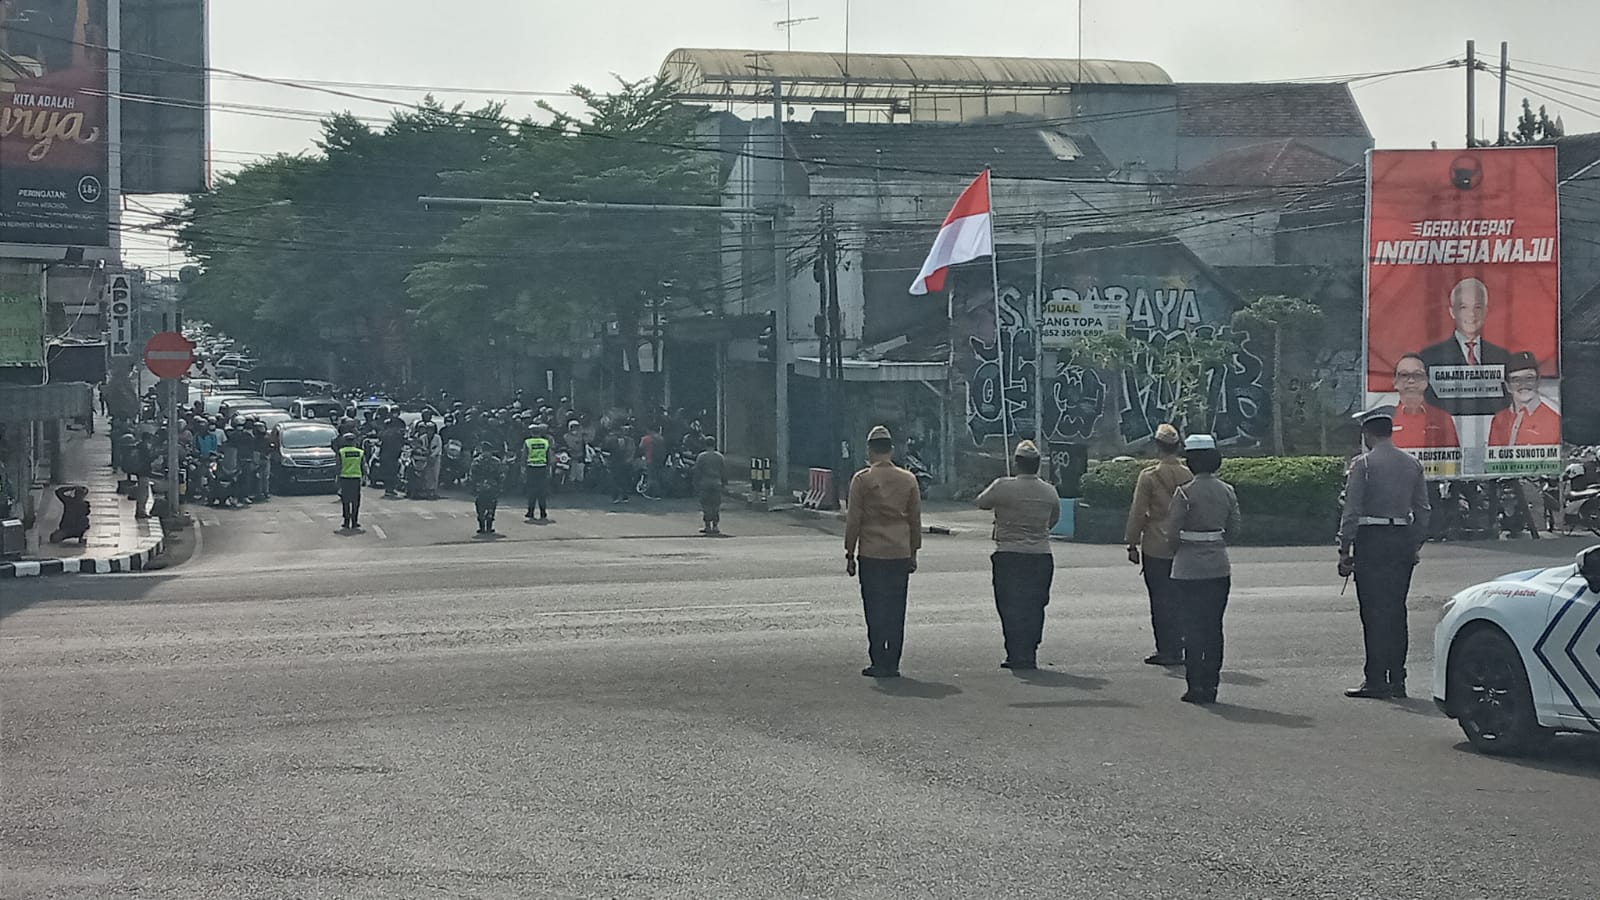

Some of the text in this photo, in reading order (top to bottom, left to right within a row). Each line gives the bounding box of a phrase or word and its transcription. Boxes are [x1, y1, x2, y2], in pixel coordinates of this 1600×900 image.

[13, 93, 75, 109] KITA ADALAH
[82, 184, 97, 194] 18+
[1420, 219, 1515, 237] GERAK CEPAT
[1373, 237, 1555, 265] INDONESIA MAJU
[111, 275, 130, 355] APOTIK
[1072, 317, 1103, 327] TOPA
[1499, 448, 1514, 460] GUS
[1516, 448, 1546, 459] SUNOTO
